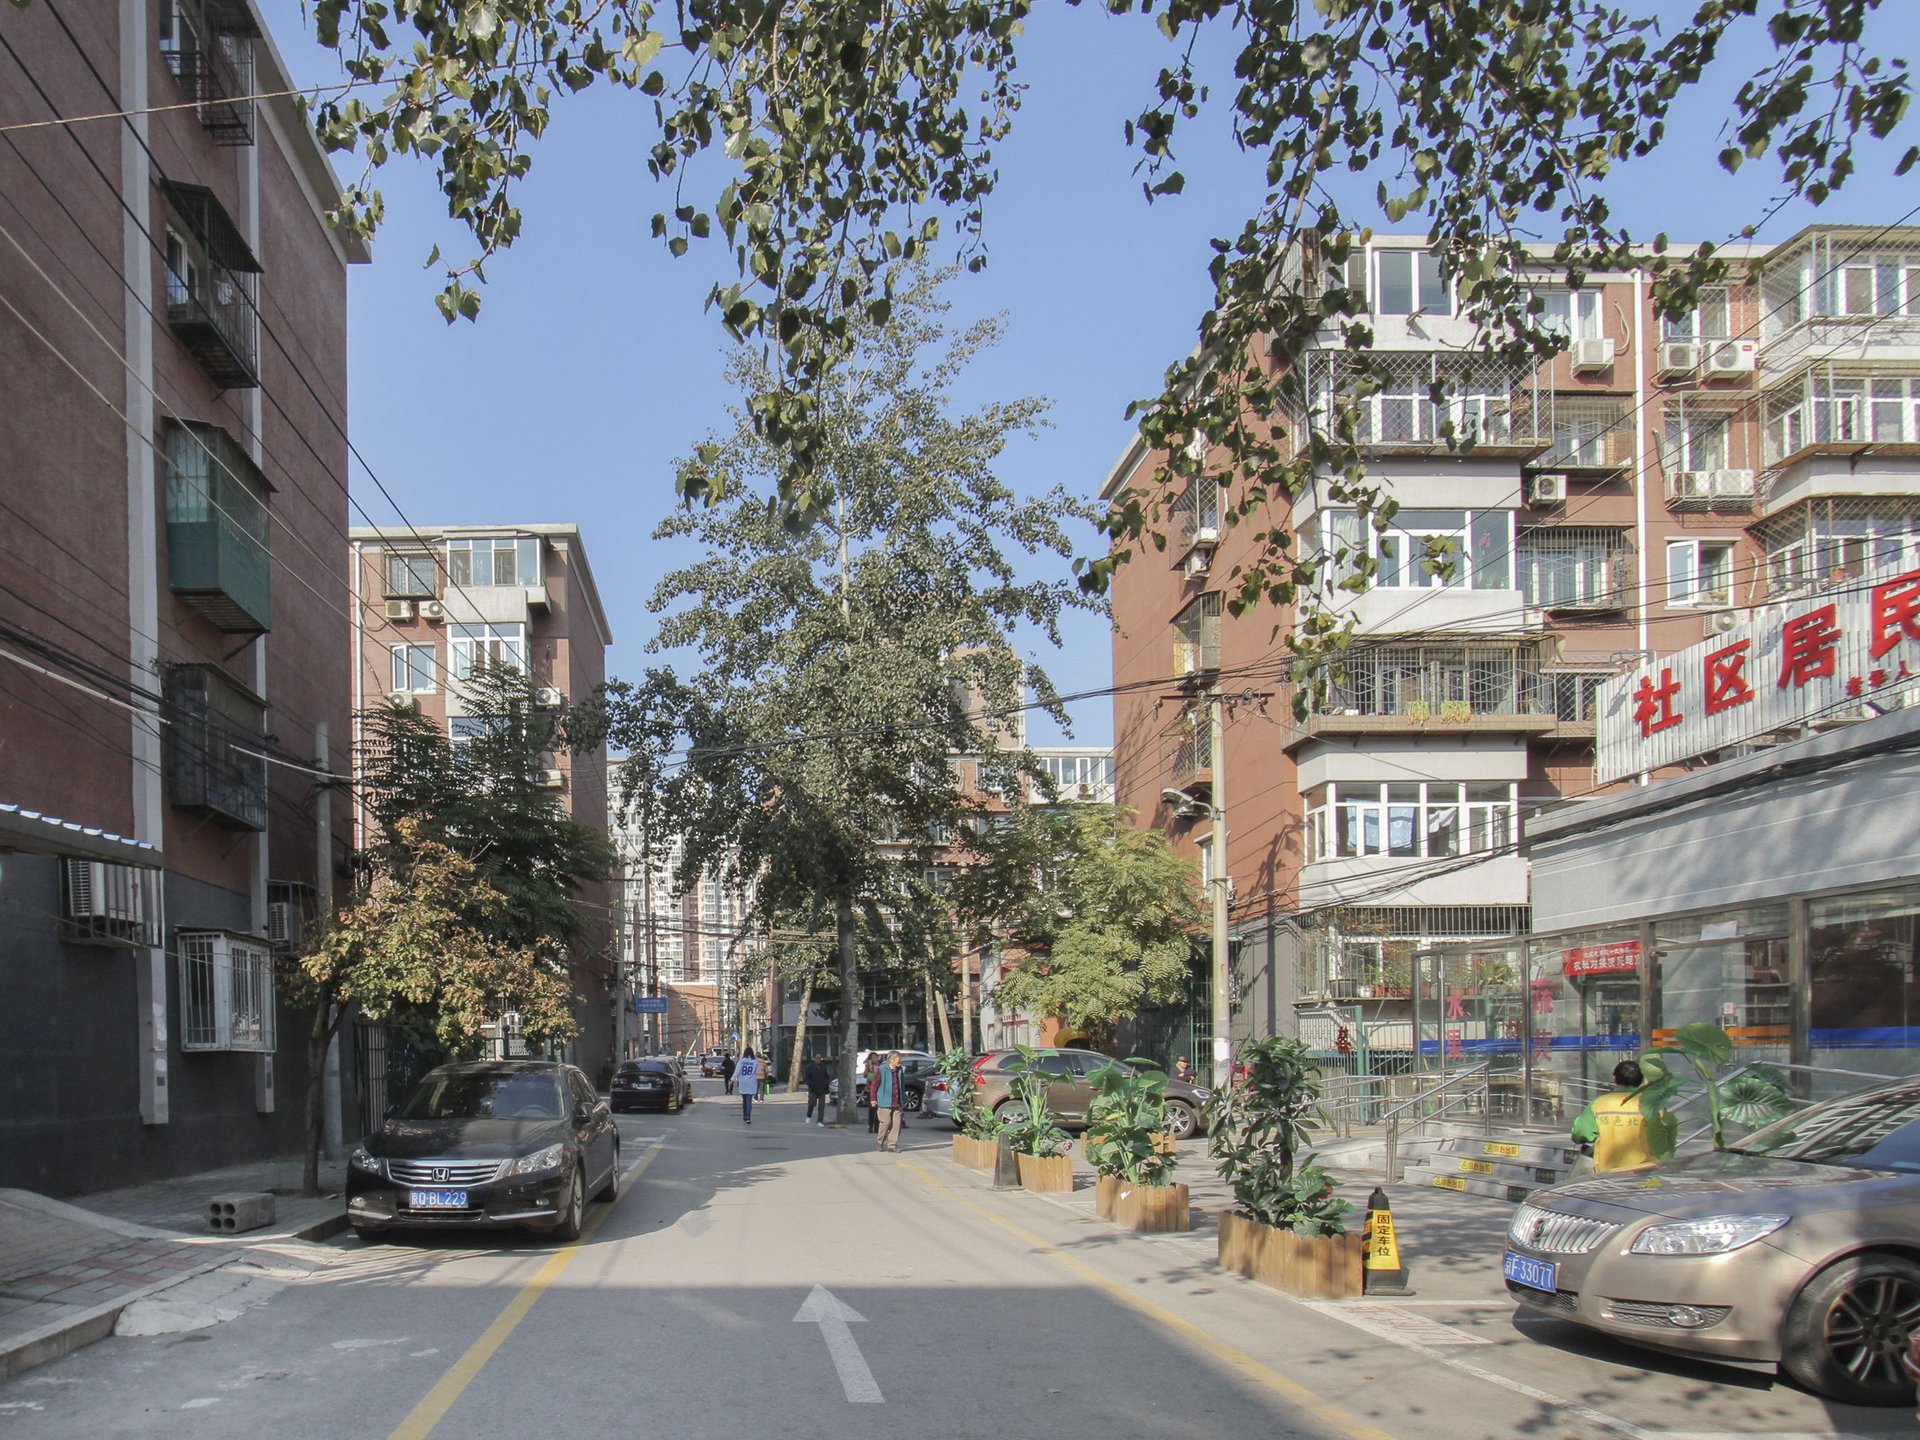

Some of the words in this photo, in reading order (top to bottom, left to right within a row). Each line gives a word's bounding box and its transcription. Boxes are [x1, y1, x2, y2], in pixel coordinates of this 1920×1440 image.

[742, 1066, 753, 1076] 88
[1377, 1214, 1391, 1256] 固定车位
[1505, 1256, 1552, 1288] 京F·33077
